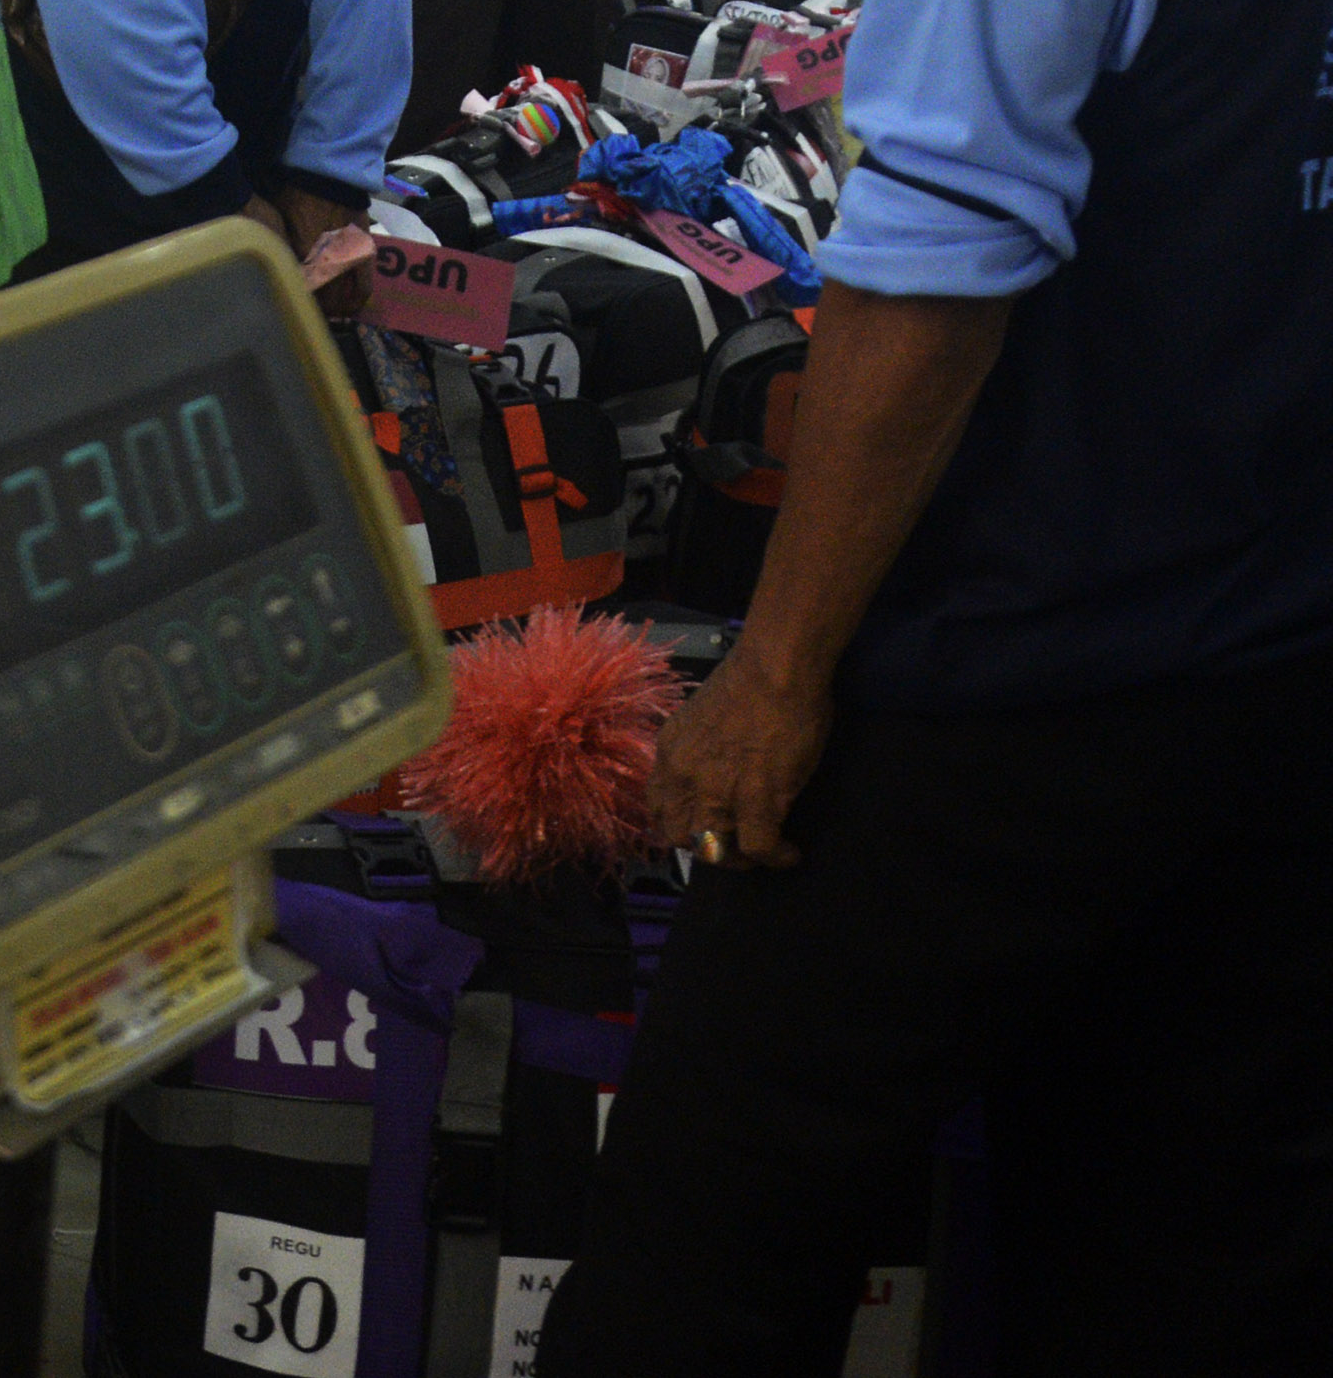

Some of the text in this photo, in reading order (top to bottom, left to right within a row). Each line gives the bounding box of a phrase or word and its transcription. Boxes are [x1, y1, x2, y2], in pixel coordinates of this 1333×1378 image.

[675, 221, 744, 267] UPG
[375, 244, 470, 294] UPG
[269, 1235, 322, 1258] REGU
[233, 1266, 338, 1354] 30
